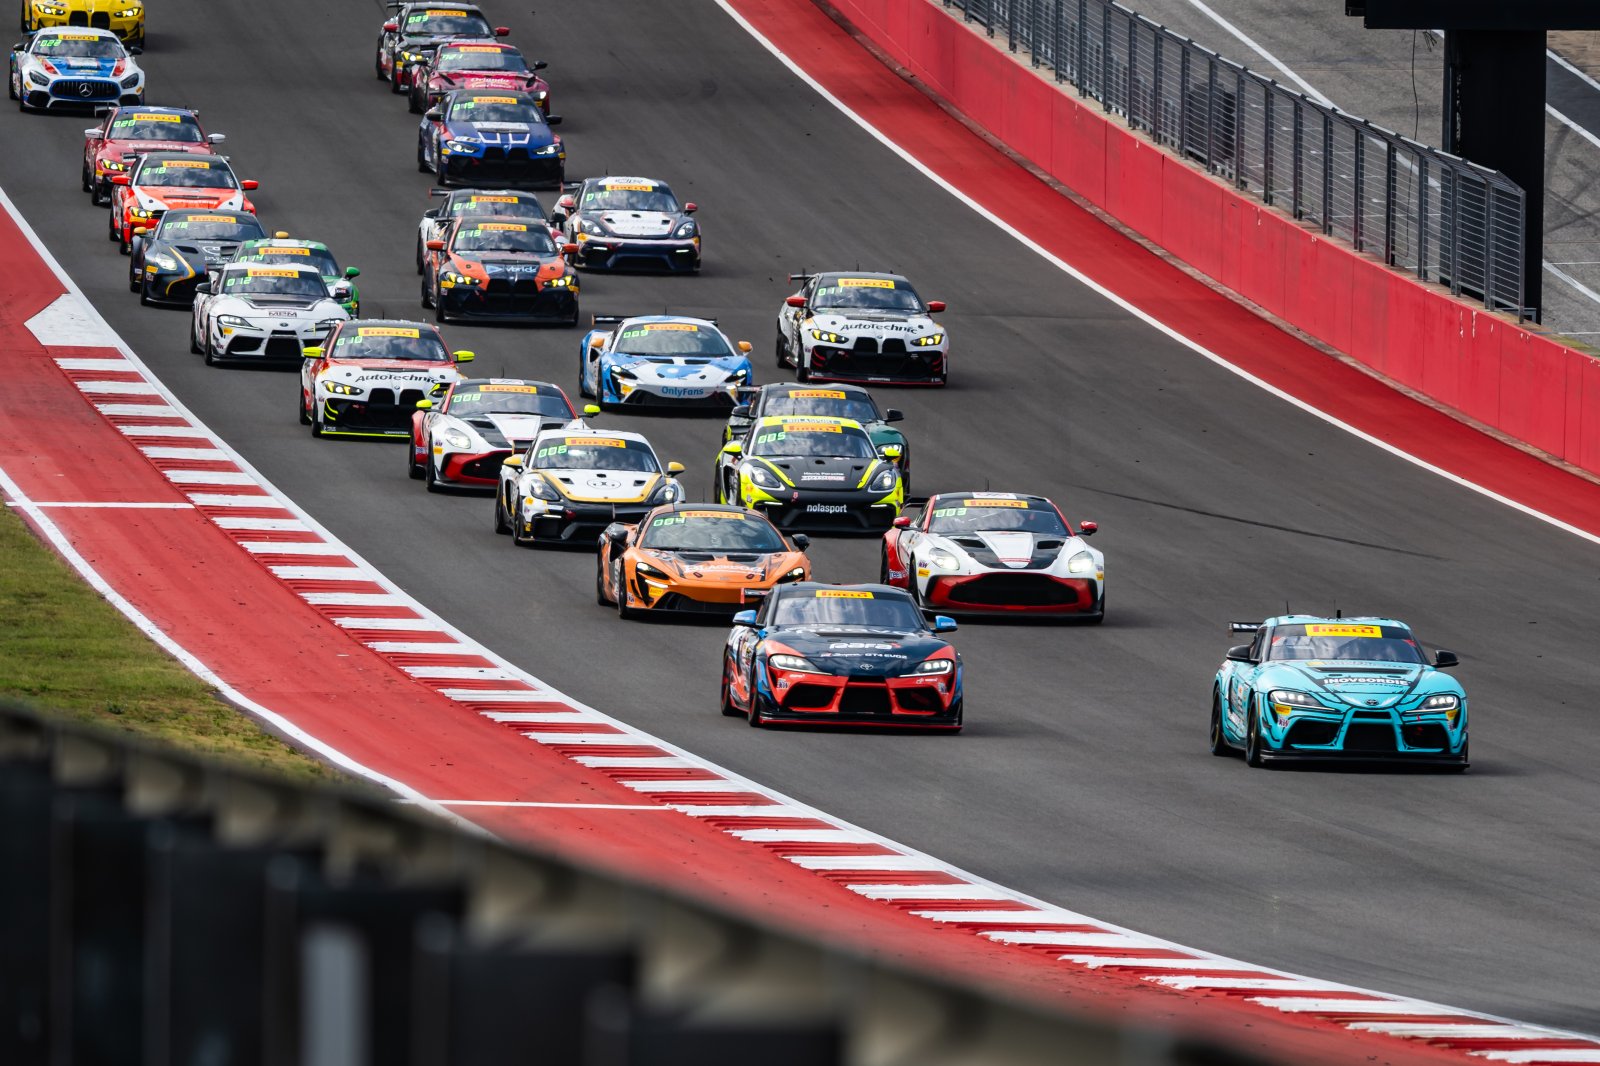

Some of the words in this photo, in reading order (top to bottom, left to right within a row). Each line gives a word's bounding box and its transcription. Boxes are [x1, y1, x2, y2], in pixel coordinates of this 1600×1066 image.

[226, 276, 252, 287] 012
[840, 324, 919, 335] AutoTechnic
[355, 374, 439, 384] AutoTechnic
[661, 386, 704, 396] OnlyFans
[757, 432, 786, 444] 005
[538, 445, 568, 458] 006
[806, 503, 847, 514] nolasport
[935, 508, 967, 517] 003
[653, 516, 686, 527] 004
[1313, 626, 1374, 634] PIRELLI
